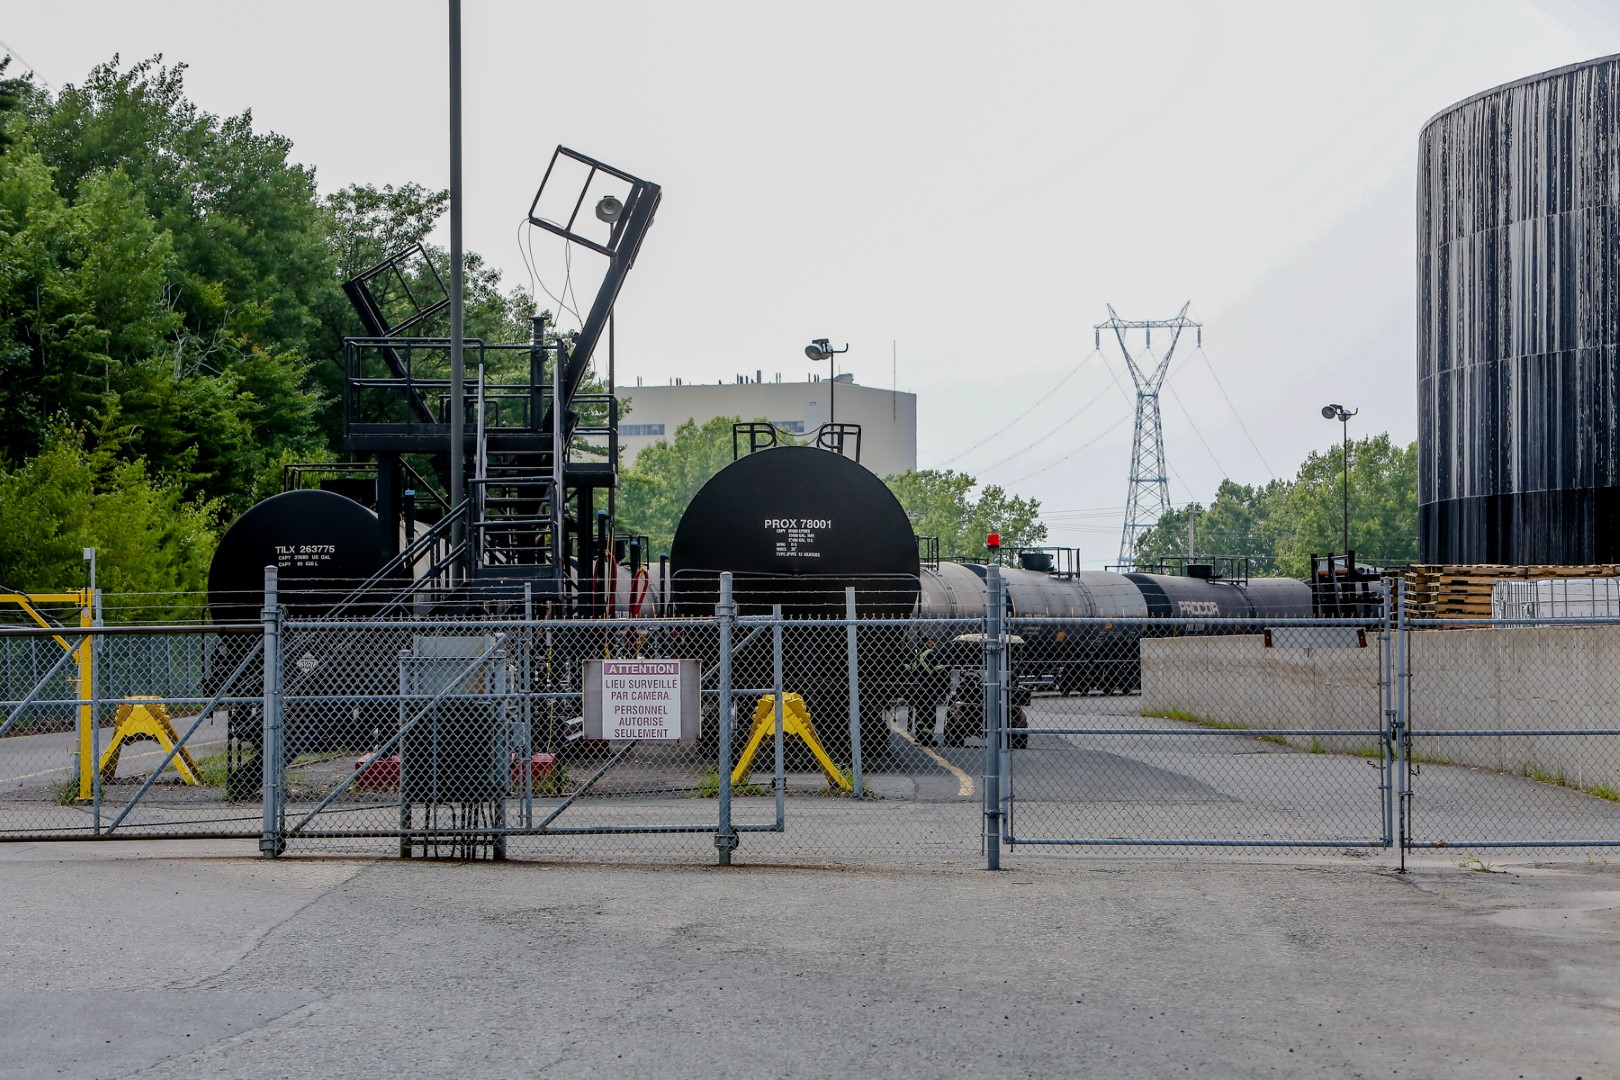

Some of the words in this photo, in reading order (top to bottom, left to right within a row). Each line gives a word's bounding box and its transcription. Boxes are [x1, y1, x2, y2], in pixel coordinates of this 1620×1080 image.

[764, 519, 797, 529] PROX
[800, 519, 832, 529] 78001
[300, 545, 335, 553] 263775
[608, 664, 674, 674] ATTENTION
[606, 680, 625, 688] LIEU
[611, 692, 628, 700] PAR
[614, 706, 668, 714] PERSONNEL
[614, 729, 668, 738] SEULEMENT
